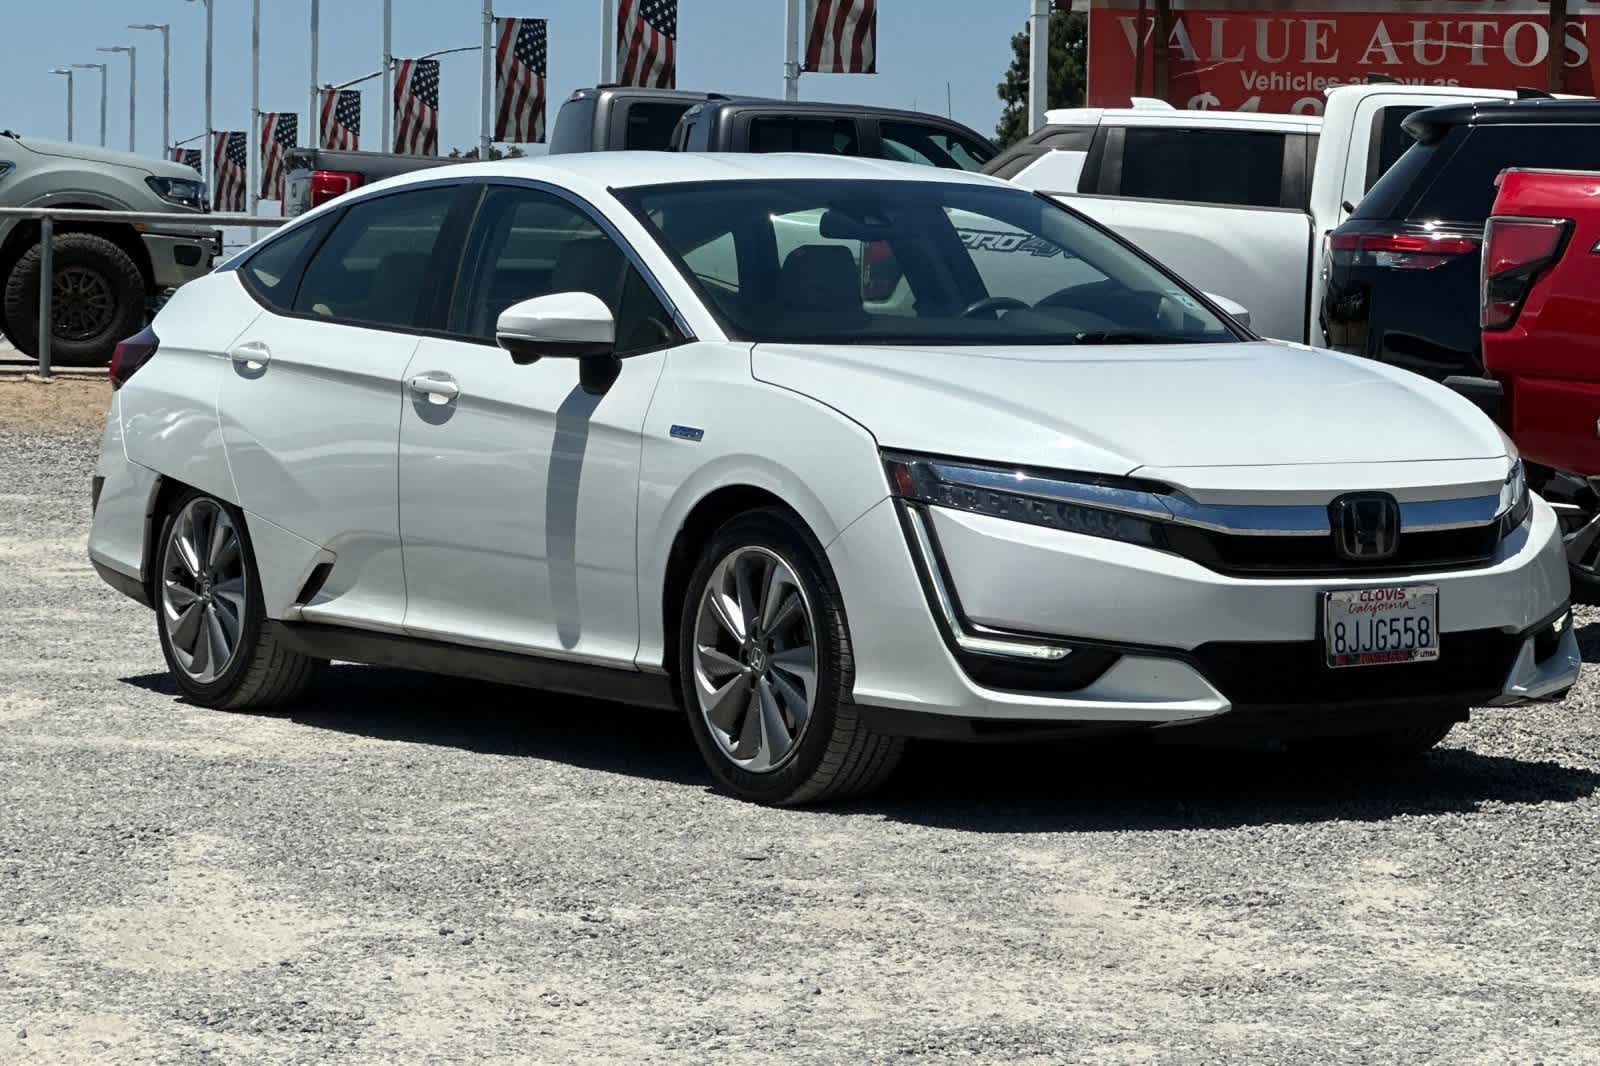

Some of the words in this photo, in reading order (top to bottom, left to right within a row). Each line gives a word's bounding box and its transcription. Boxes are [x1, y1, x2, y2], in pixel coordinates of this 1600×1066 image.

[1115, 15, 1340, 64] VALUE
[1357, 19, 1590, 68] AUTOS
[1348, 600, 1410, 617] California
[1360, 588, 1406, 602] CLOVIS
[1334, 615, 1431, 654] 8JJG558
